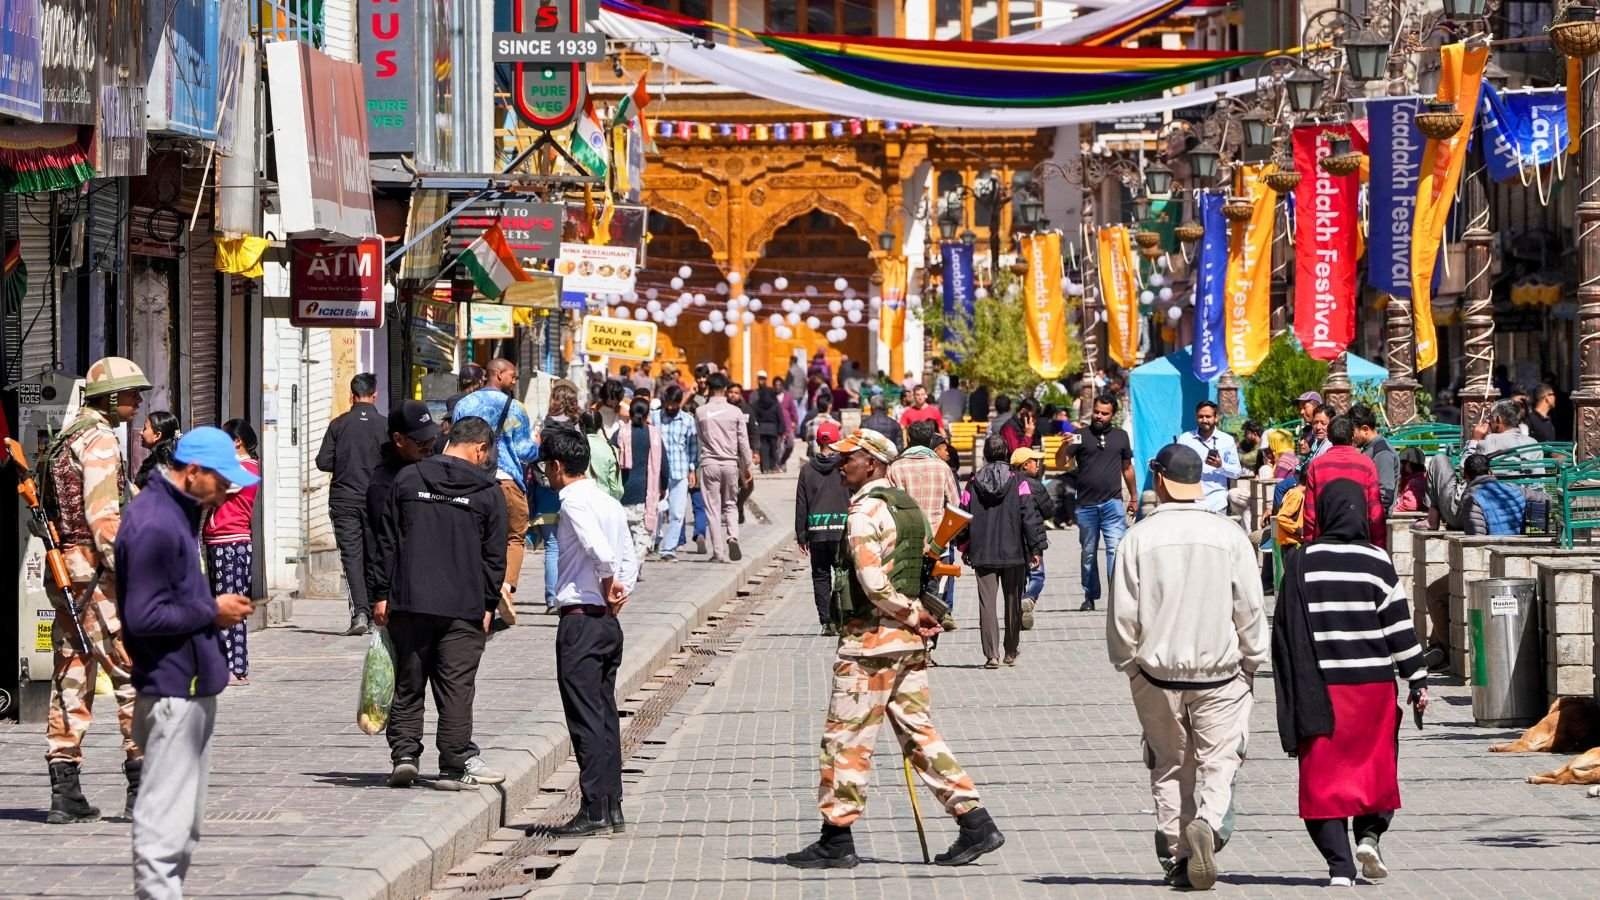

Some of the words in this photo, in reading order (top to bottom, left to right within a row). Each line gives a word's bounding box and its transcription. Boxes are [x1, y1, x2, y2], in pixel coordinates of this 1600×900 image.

[371, 0, 400, 79] US
[498, 40, 552, 55] SINCE
[556, 40, 597, 55] 1939
[530, 86, 566, 97] PURE
[367, 99, 408, 112] PURE
[535, 102, 563, 113] VEG
[373, 115, 405, 129] VEG
[485, 207, 510, 216] WAY
[513, 208, 529, 217] TO
[481, 229, 530, 239] EETS
[1392, 194, 1416, 288] Festival
[582, 249, 631, 257] RESTAURANT
[306, 252, 372, 277] ATM
[1313, 248, 1338, 348] Festival
[318, 308, 344, 316] ICICI
[345, 308, 369, 317] Bank
[593, 324, 617, 335] TAXI
[1232, 280, 1254, 367] Festival
[1118, 304, 1131, 362] Festival
[592, 336, 635, 348] SERVICE
[1036, 312, 1057, 373] Festival
[20, 394, 40, 404] TOES
[417, 491, 431, 499] THE
[37, 624, 52, 632] Has
